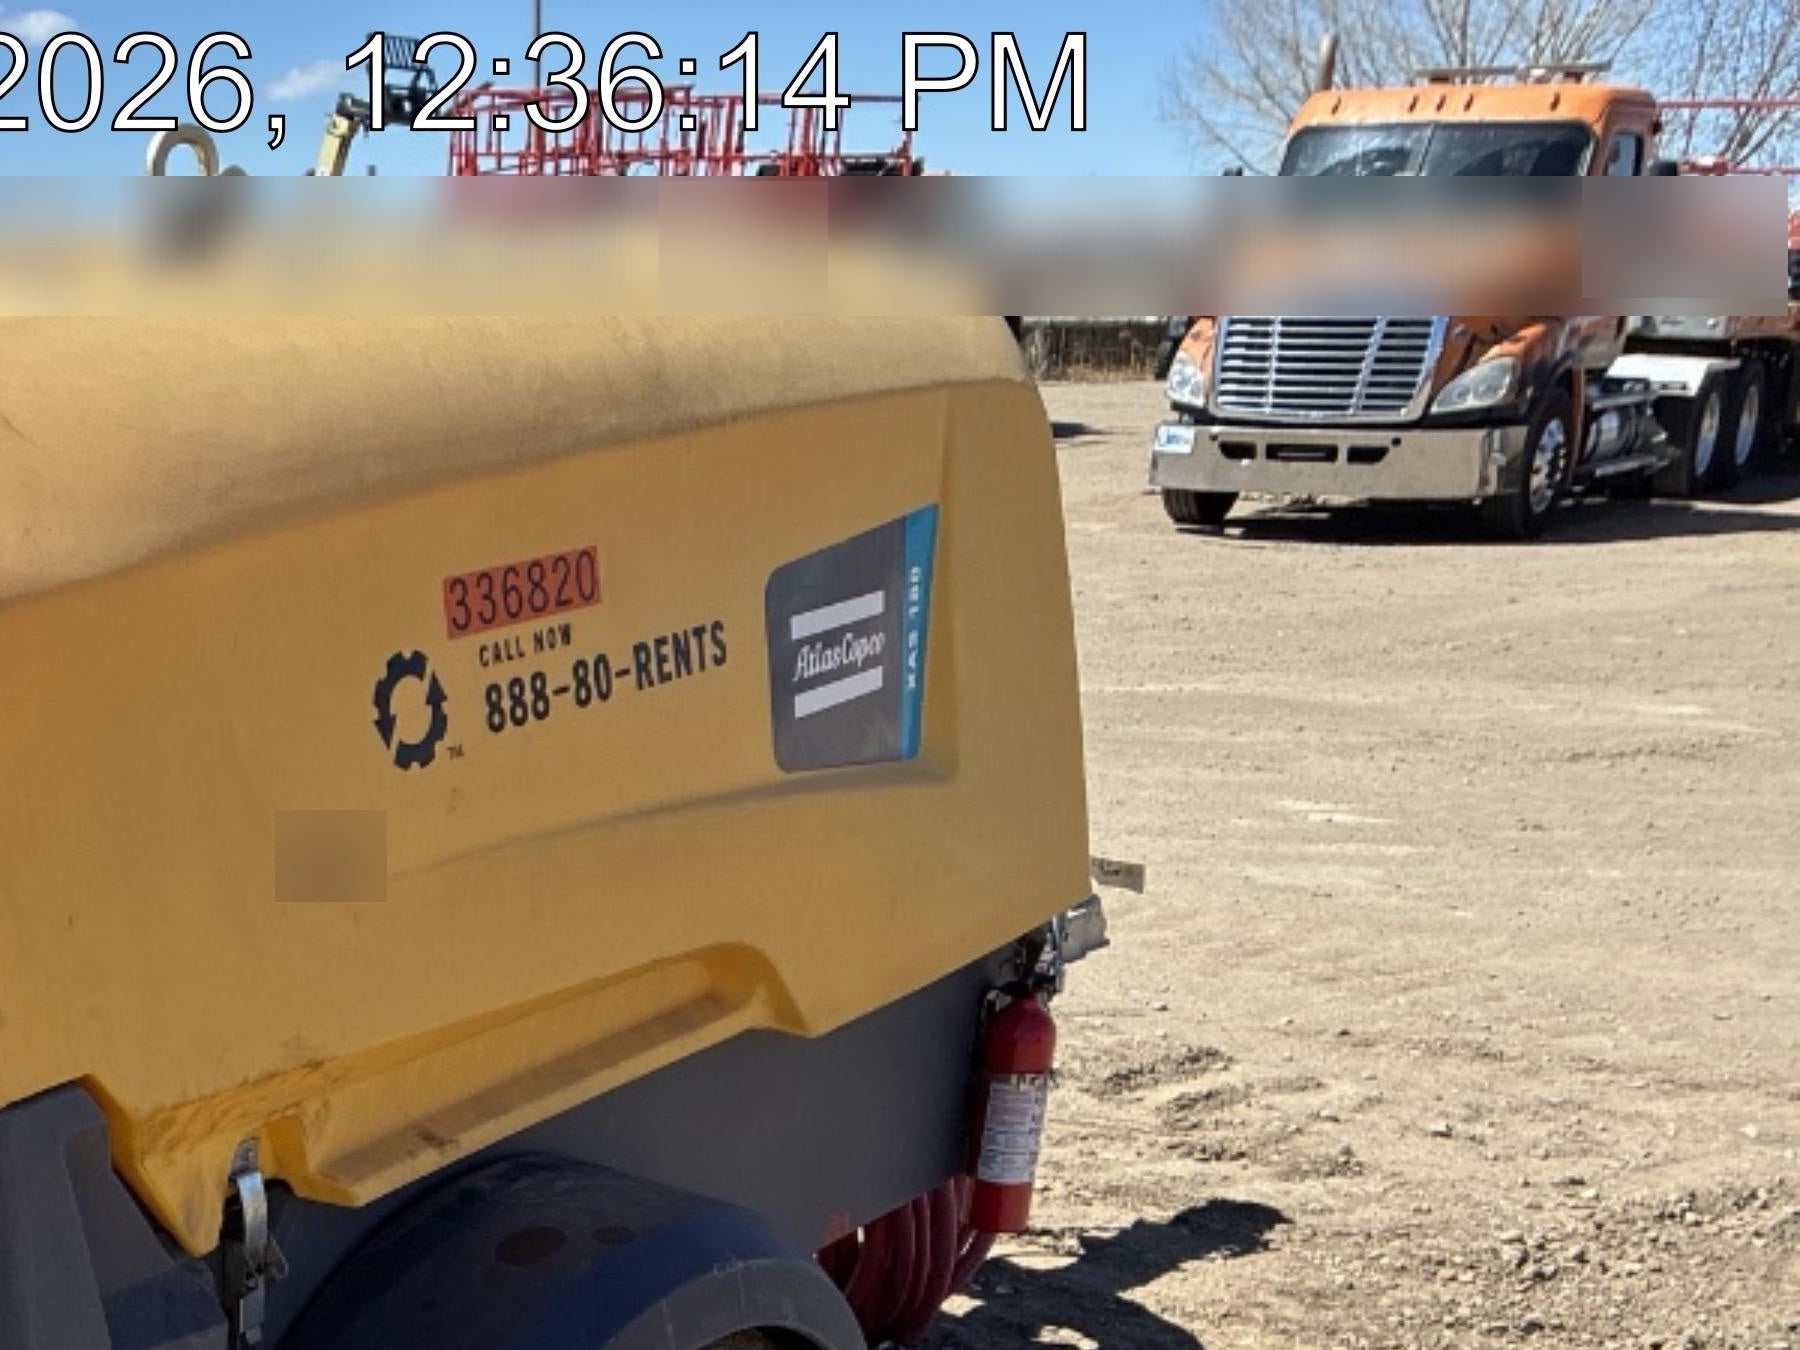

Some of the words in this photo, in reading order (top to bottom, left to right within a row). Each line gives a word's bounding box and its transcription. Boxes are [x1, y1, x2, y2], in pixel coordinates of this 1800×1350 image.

[449, 549, 597, 633] 336820
[479, 635, 526, 668] CALL
[533, 622, 572, 653] NOW
[485, 620, 728, 734] 888-80-RENTS
